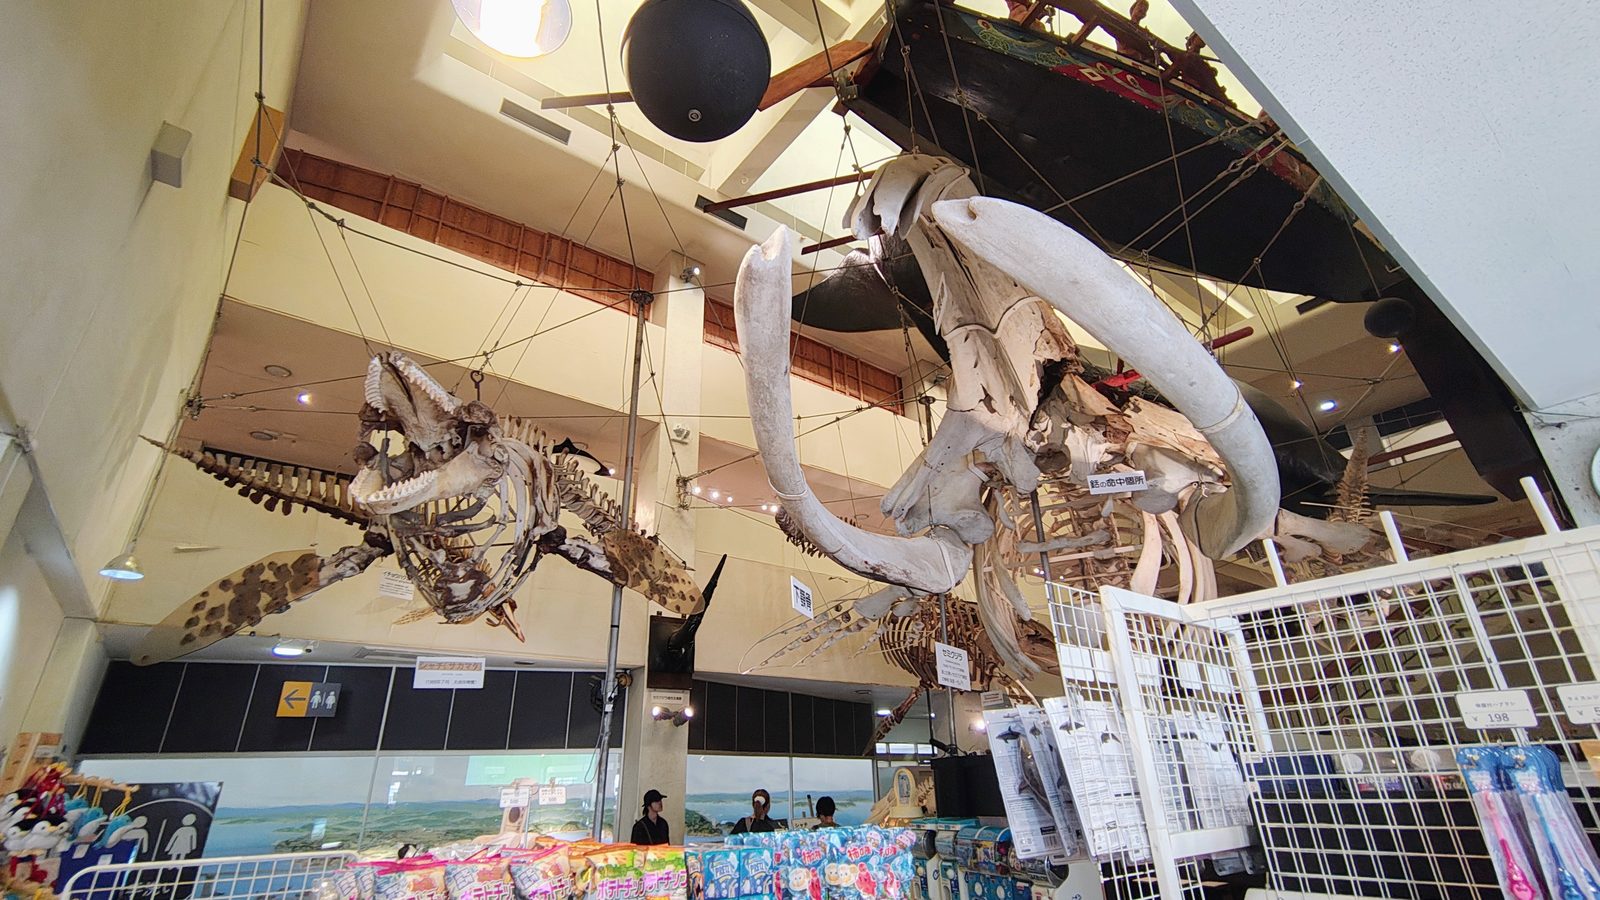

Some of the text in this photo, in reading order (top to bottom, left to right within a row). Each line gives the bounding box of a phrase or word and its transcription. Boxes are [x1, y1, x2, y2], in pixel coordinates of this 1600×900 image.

[942, 648, 963, 661] セミクジラ
[1487, 712, 1510, 723] 198
